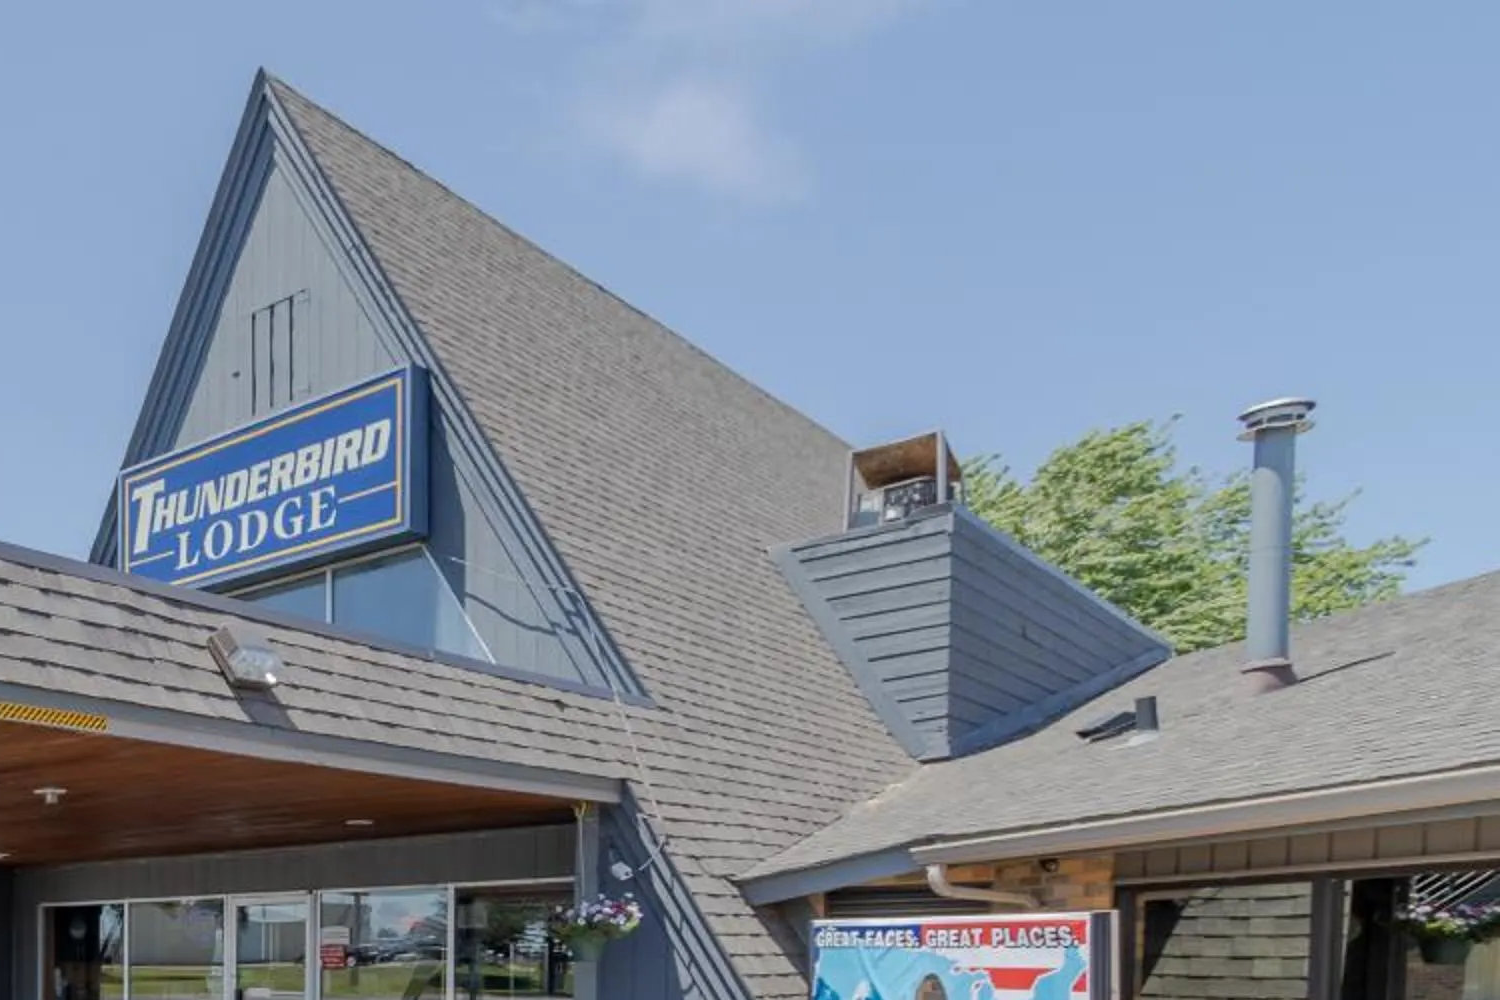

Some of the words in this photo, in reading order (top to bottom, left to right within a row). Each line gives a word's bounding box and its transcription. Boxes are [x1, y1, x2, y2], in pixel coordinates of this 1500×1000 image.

[131, 418, 392, 556] THUNDERBIRD
[175, 485, 337, 571] LODGE
[815, 930, 860, 948] GREAT
[925, 928, 983, 948] GREAT
[991, 925, 1080, 949] PLACES.
